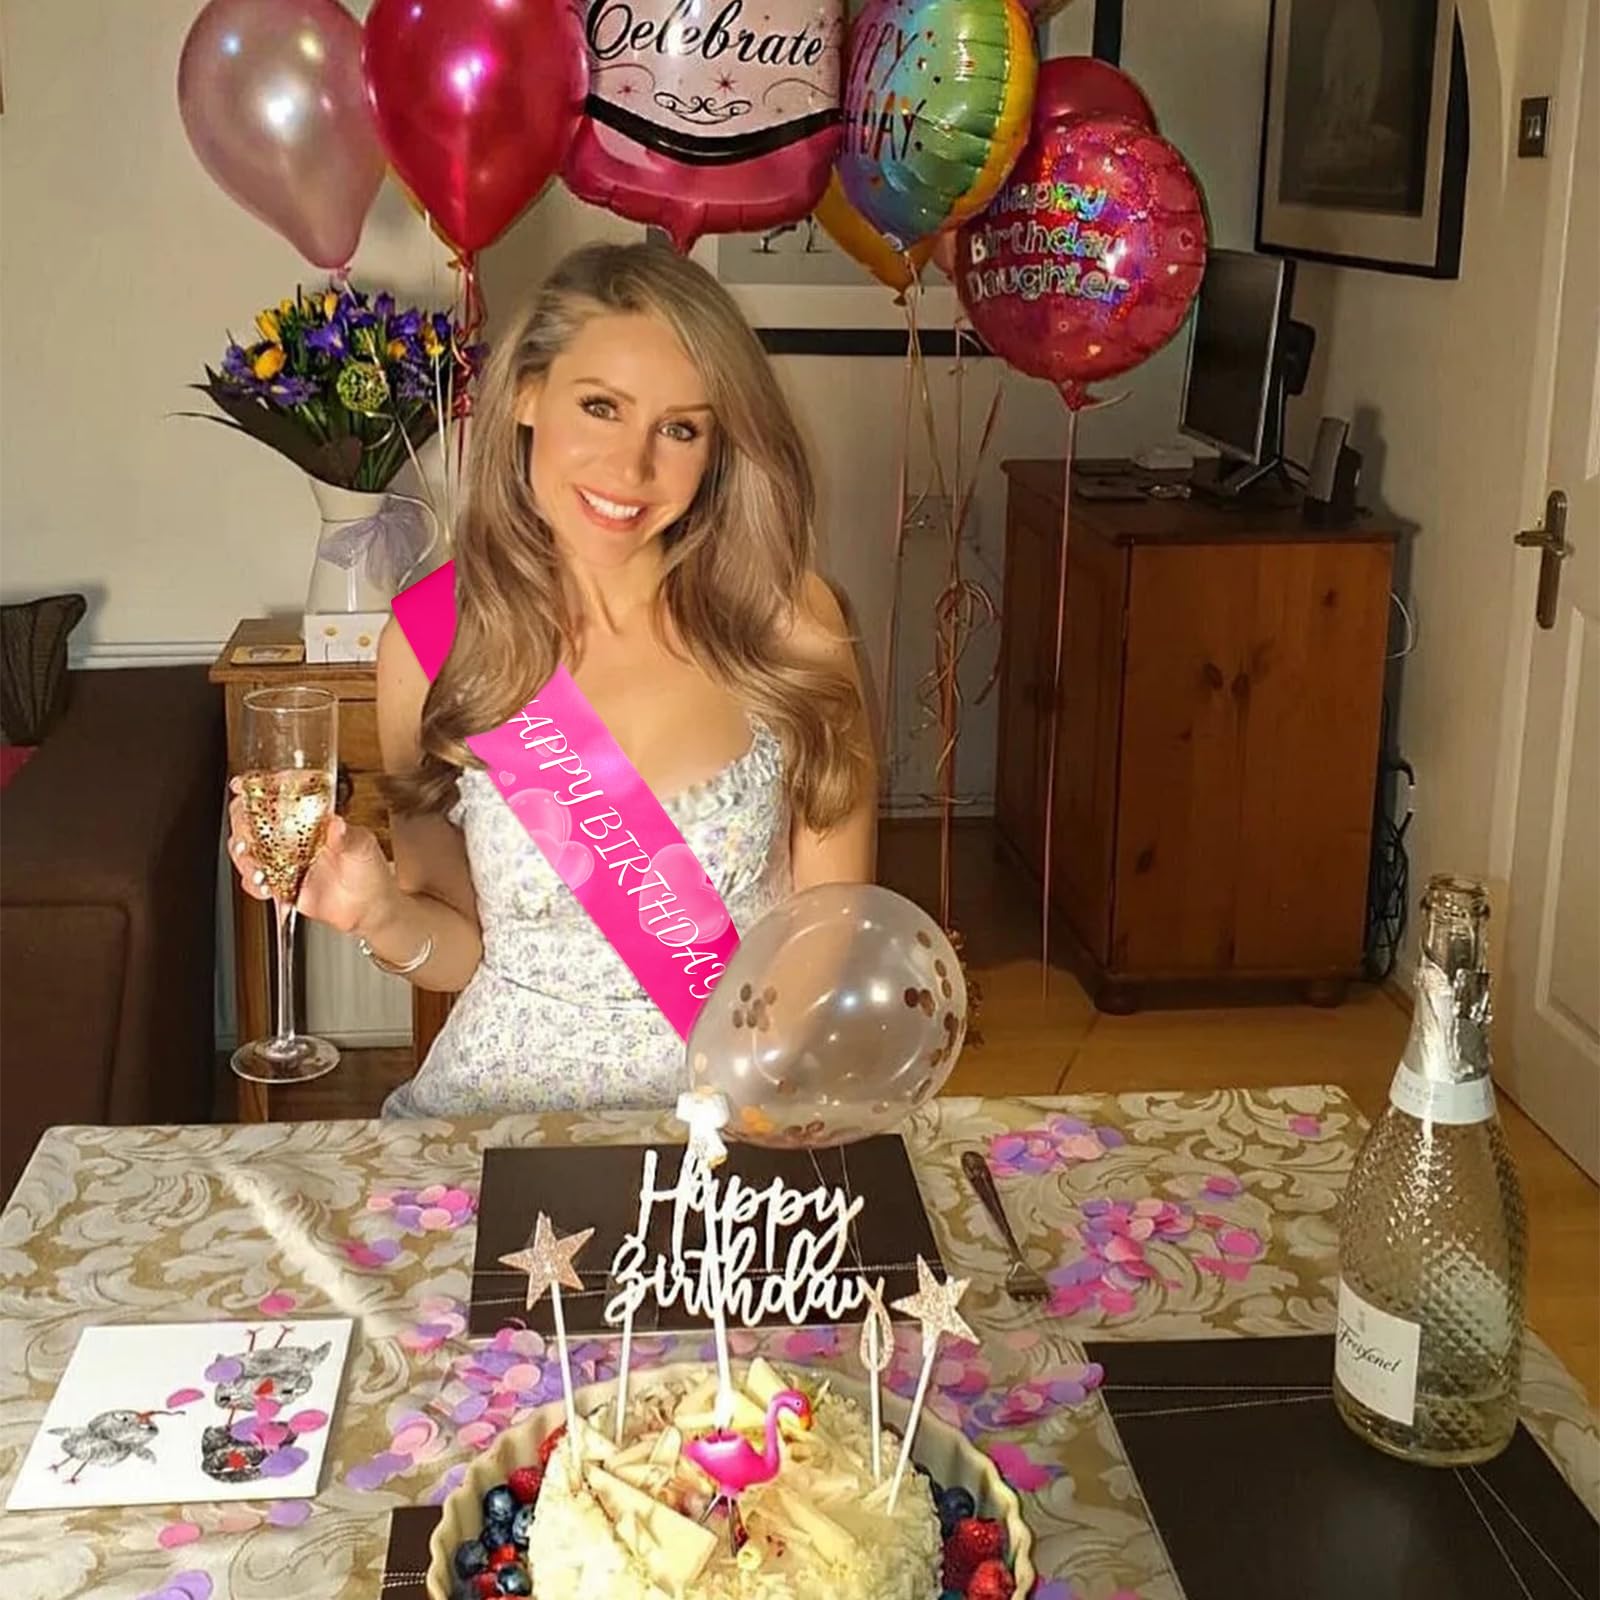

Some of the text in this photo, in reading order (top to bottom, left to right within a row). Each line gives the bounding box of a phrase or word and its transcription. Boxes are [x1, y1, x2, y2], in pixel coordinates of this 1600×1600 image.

[586, 0, 822, 66] Celebrate
[970, 220, 1128, 273] Birthday
[966, 258, 1130, 304] Daughter
[506, 700, 604, 806] APPY
[637, 1149, 865, 1276] Happy
